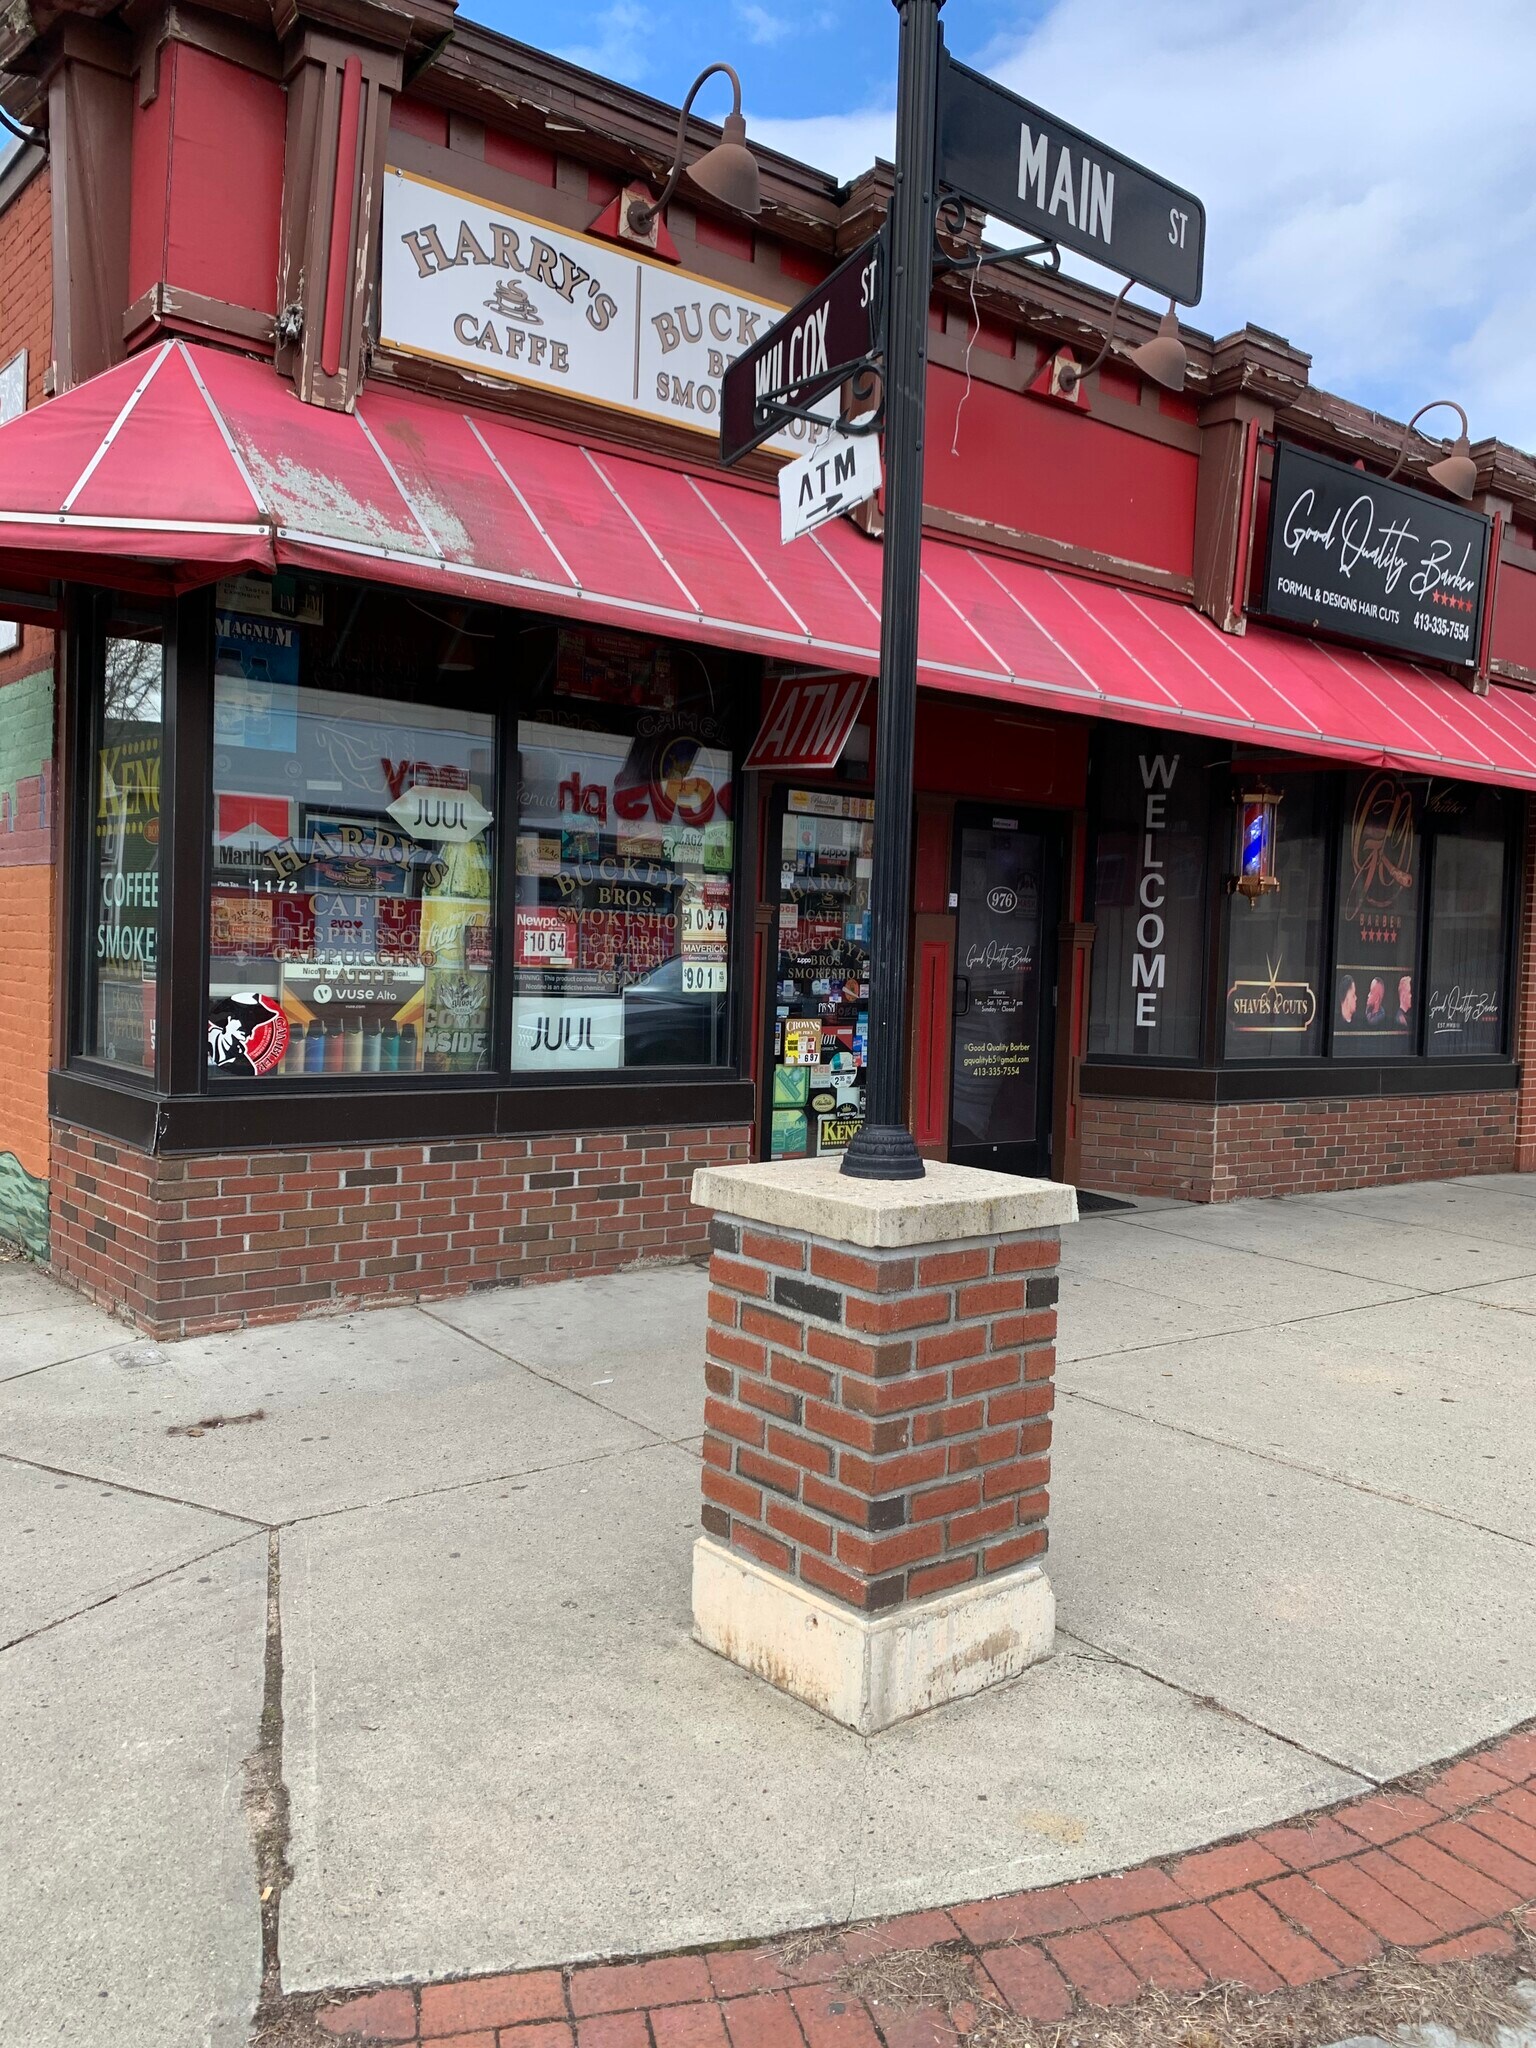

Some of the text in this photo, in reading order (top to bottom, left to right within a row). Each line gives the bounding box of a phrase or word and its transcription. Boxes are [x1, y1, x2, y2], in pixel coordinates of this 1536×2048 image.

[1017, 121, 1189, 250] MAIN ST
[401, 219, 618, 333] HARRY'S
[651, 301, 776, 355] BUCK
[755, 260, 878, 421] WILCOX ST
[453, 313, 570, 373] CAFFE
[799, 444, 857, 508] ATM
[1283, 488, 1475, 602] Good Quality Barber
[1277, 577, 1401, 625] FORMAL & DESIGNS HAIR CUTS
[215, 618, 292, 648] MAGNUM
[1412, 611, 1470, 642] 413-335-7554
[755, 680, 861, 759] ATM
[413, 798, 468, 831] JUUL
[264, 823, 450, 889] HARRY'S
[820, 846, 847, 858] zippo
[103, 871, 159, 908] COFFEE
[553, 857, 697, 906] BUCKEYE
[1131, 754, 1181, 1028] WELCOME
[308, 892, 407, 919] CAFFE
[597, 887, 657, 907] BROS.
[991, 892, 1013, 908] 976
[556, 905, 692, 931] SMOKESHOP
[806, 909, 850, 923] CAFFE
[297, 925, 417, 947] ESPRESSO
[589, 933, 662, 951] CIGARS
[683, 943, 726, 954] MAVERICK
[272, 943, 438, 968] CAPPUCCINO
[581, 950, 666, 969] LOTTERY
[787, 935, 868, 964] BUCKEYE
[810, 954, 844, 967] BROS.
[318, 967, 396, 986] LATTE
[597, 970, 651, 986] KENO
[787, 966, 864, 980] SMOKESHOP
[376, 990, 397, 1001] Alto
[1233, 998, 1271, 1015] SHAVES
[1282, 1000, 1308, 1015] CUTS
[530, 1016, 595, 1052] JUUL
[785, 1020, 821, 1033] CROWNS
[986, 1042, 1009, 1053] Quality
[1009, 1042, 1030, 1052] Barber
[972, 1066, 1020, 1077] 413-335-7554
